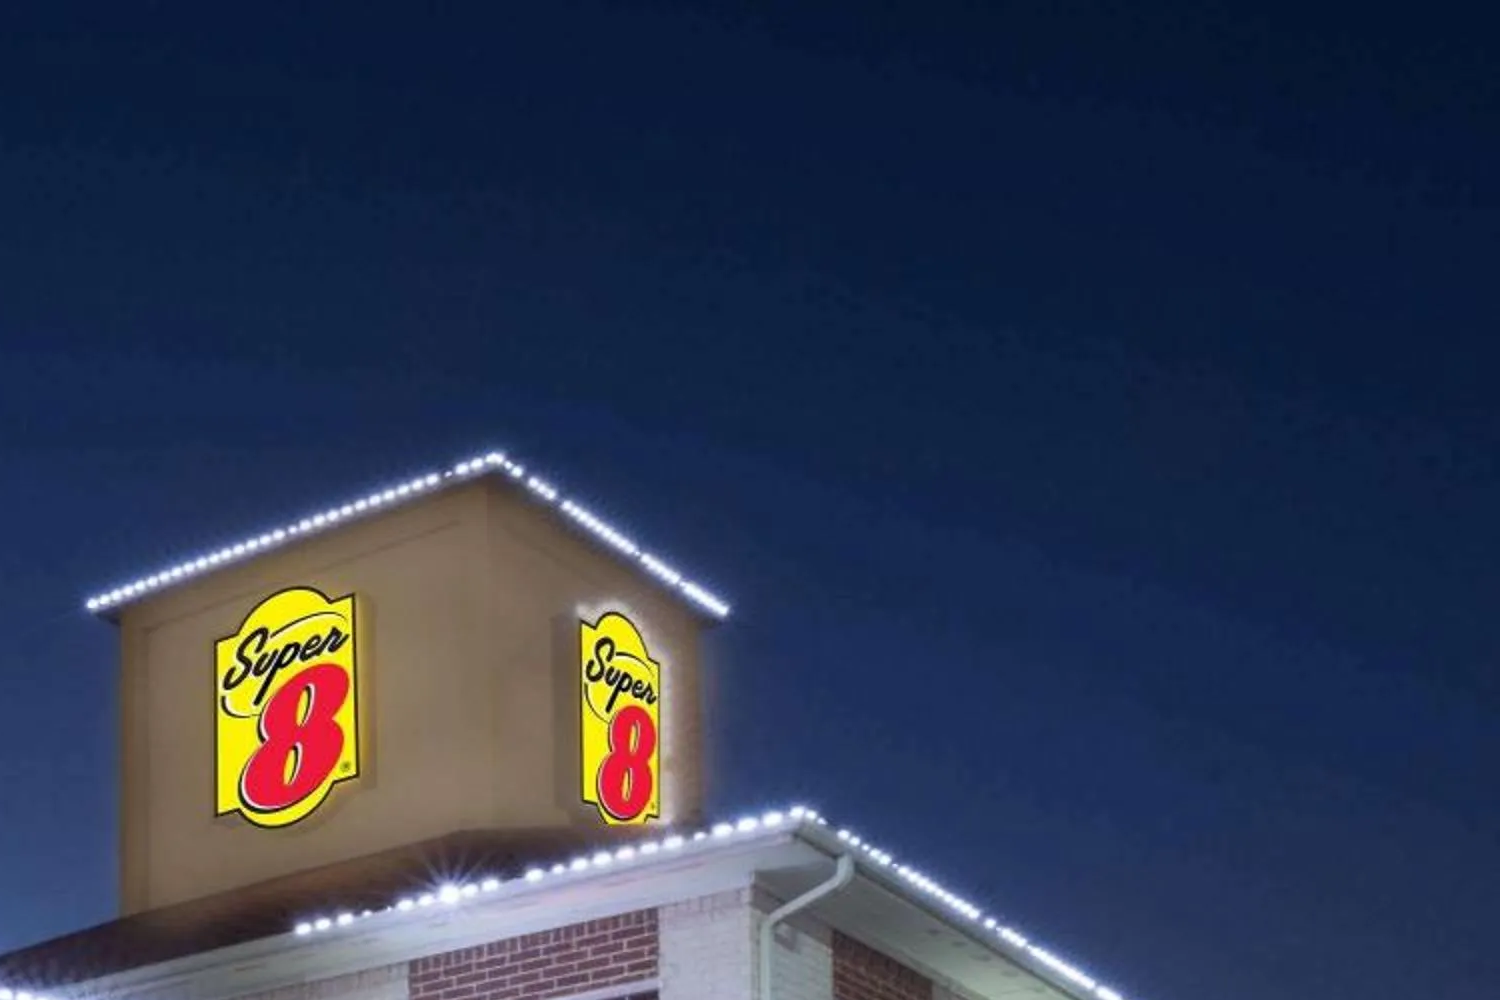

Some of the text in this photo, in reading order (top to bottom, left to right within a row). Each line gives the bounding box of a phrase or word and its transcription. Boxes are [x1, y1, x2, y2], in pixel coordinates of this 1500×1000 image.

[223, 626, 349, 706] Super
[586, 636, 656, 713] Super
[238, 662, 350, 814] 8
[596, 705, 657, 821] 8
